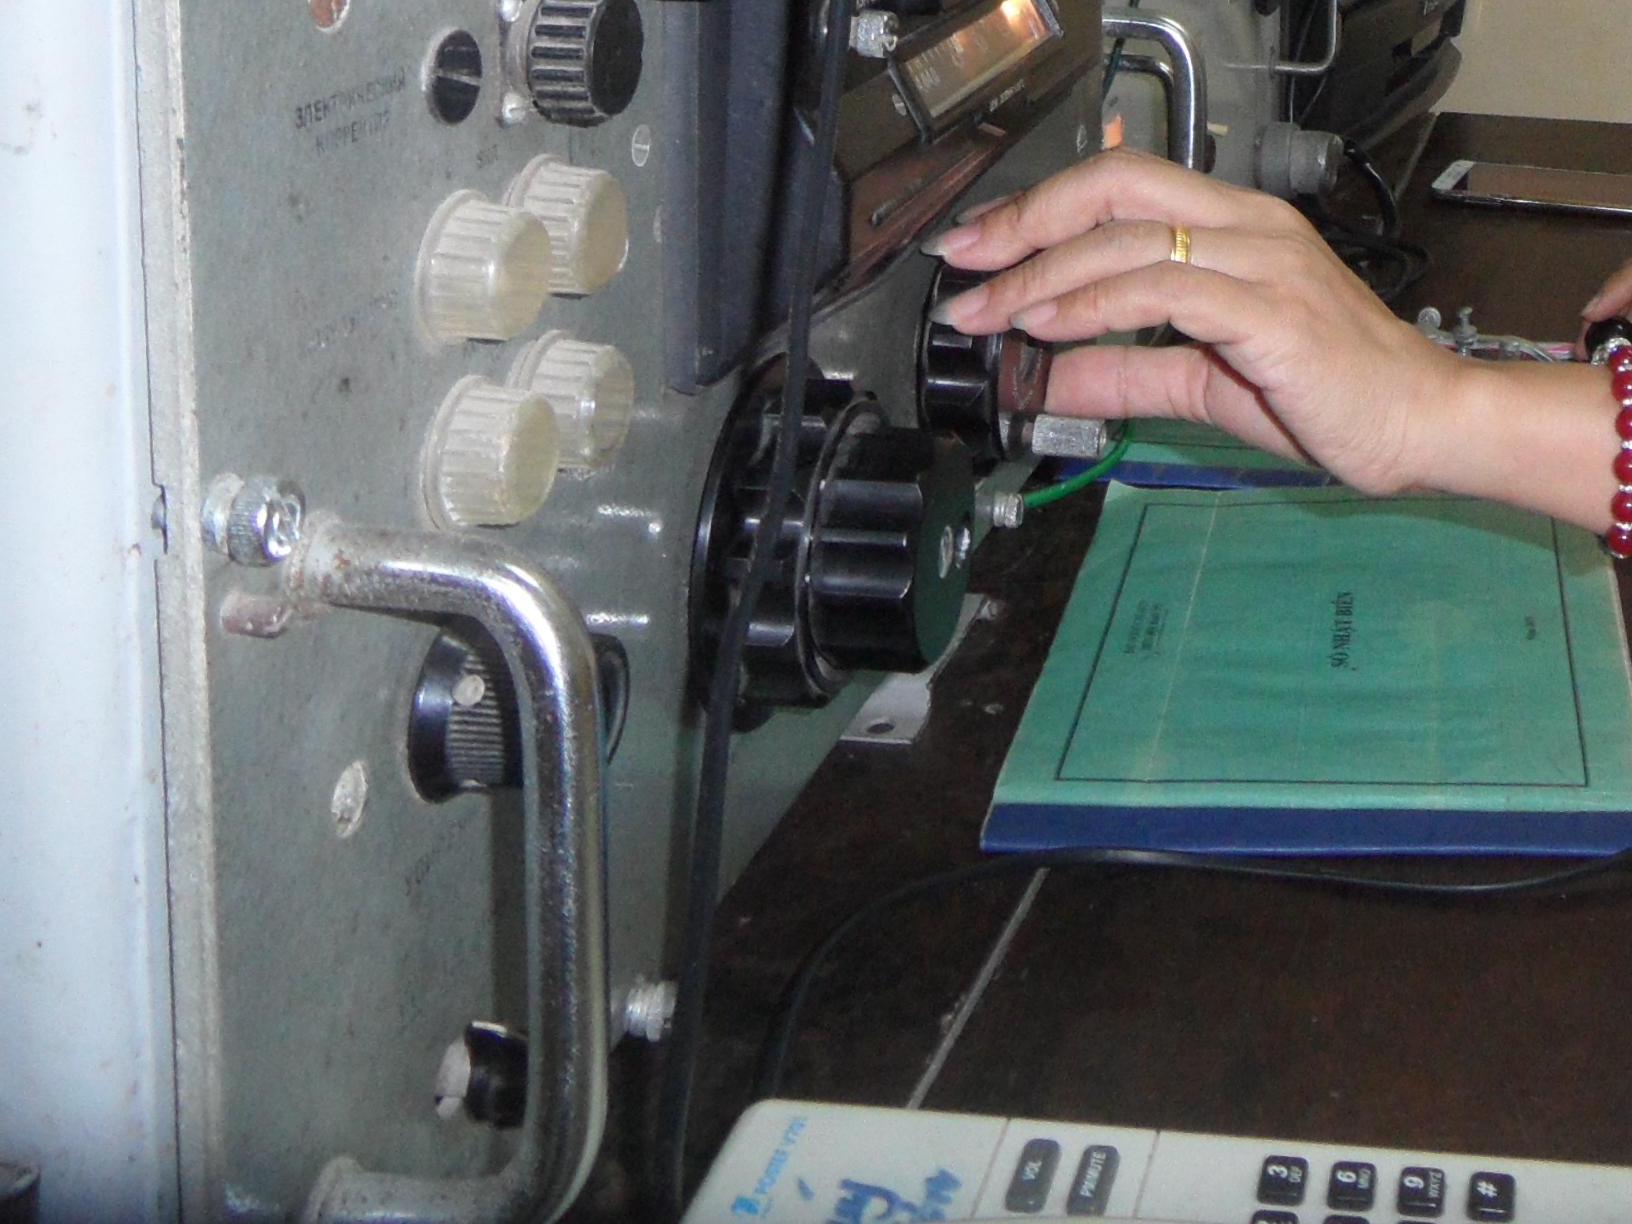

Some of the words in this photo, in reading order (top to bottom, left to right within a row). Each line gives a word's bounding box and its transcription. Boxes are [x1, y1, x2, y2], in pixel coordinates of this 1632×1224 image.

[1022, 1161, 1042, 1181] VOL
[1268, 1165, 1288, 1178] 3
[1337, 1170, 1357, 1183] 6
[1403, 1176, 1424, 1189] 9
